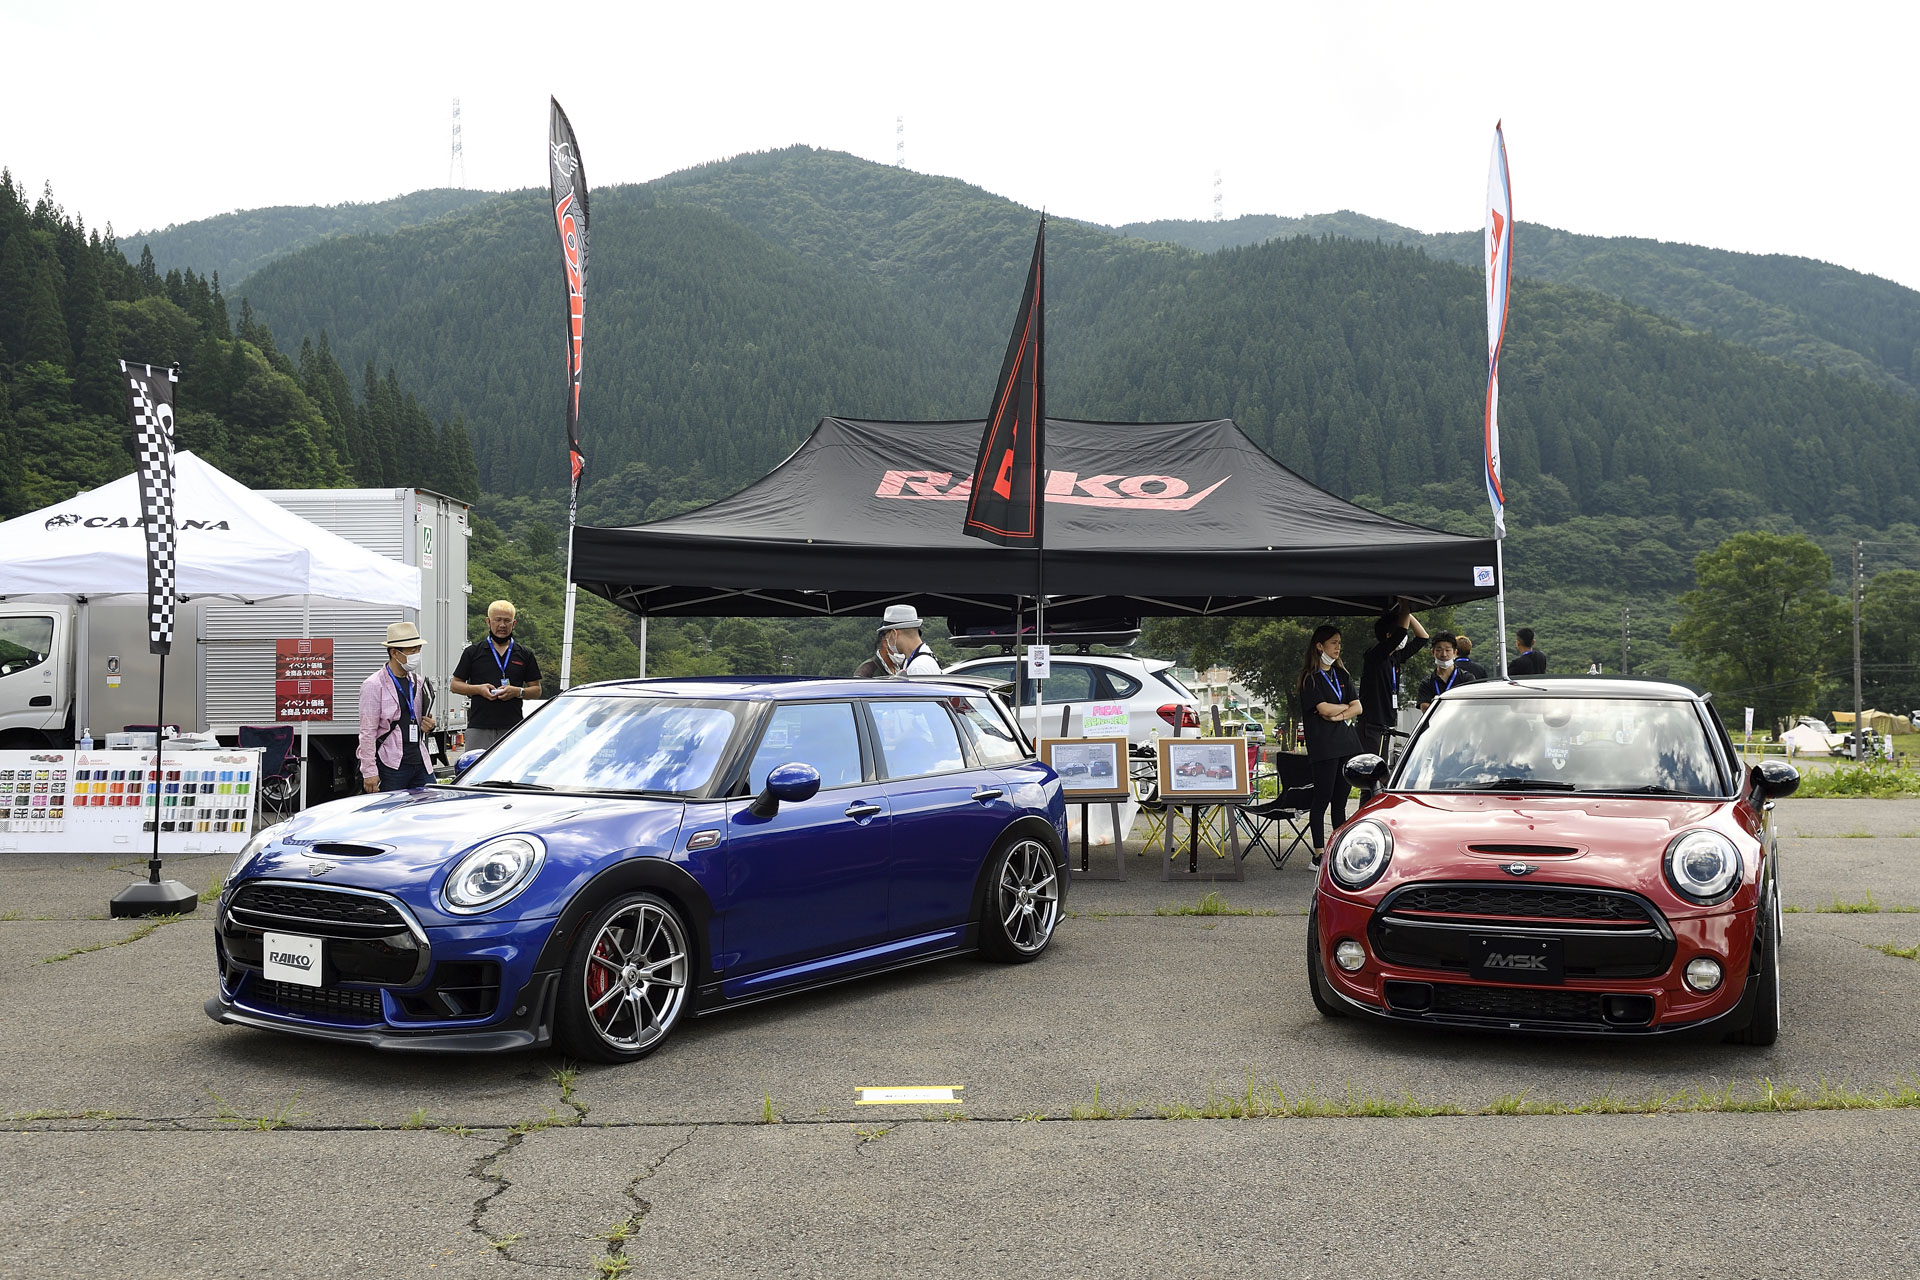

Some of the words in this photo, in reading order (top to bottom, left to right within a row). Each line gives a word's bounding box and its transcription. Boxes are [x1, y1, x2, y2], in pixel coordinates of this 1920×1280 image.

[83, 516, 230, 531] CANA
[284, 699, 325, 707] イベント価格
[269, 951, 312, 969] RAIKO
